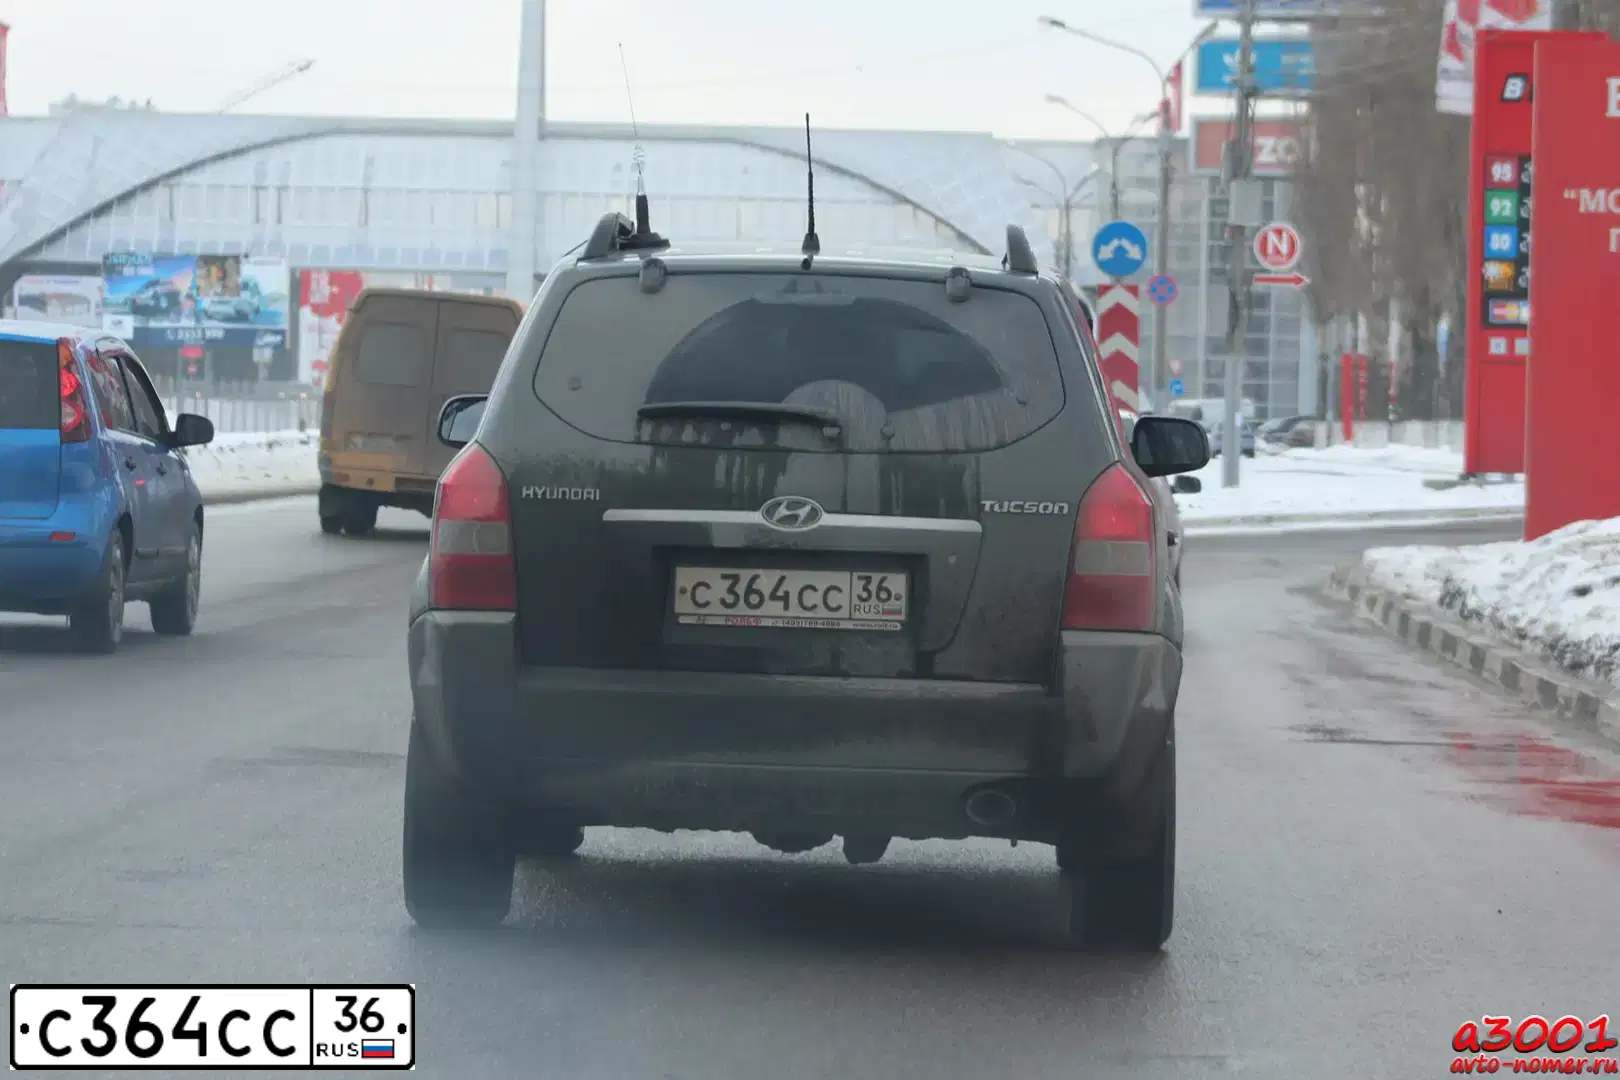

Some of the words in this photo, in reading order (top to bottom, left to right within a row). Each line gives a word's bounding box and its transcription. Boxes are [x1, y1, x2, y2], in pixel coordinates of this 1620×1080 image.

[1490, 197, 1512, 217] 92
[1266, 230, 1290, 256] N
[521, 486, 600, 502] HYUNDAI
[981, 500, 1069, 515] TUCSON
[857, 575, 892, 604] 36
[853, 604, 881, 615] RUS
